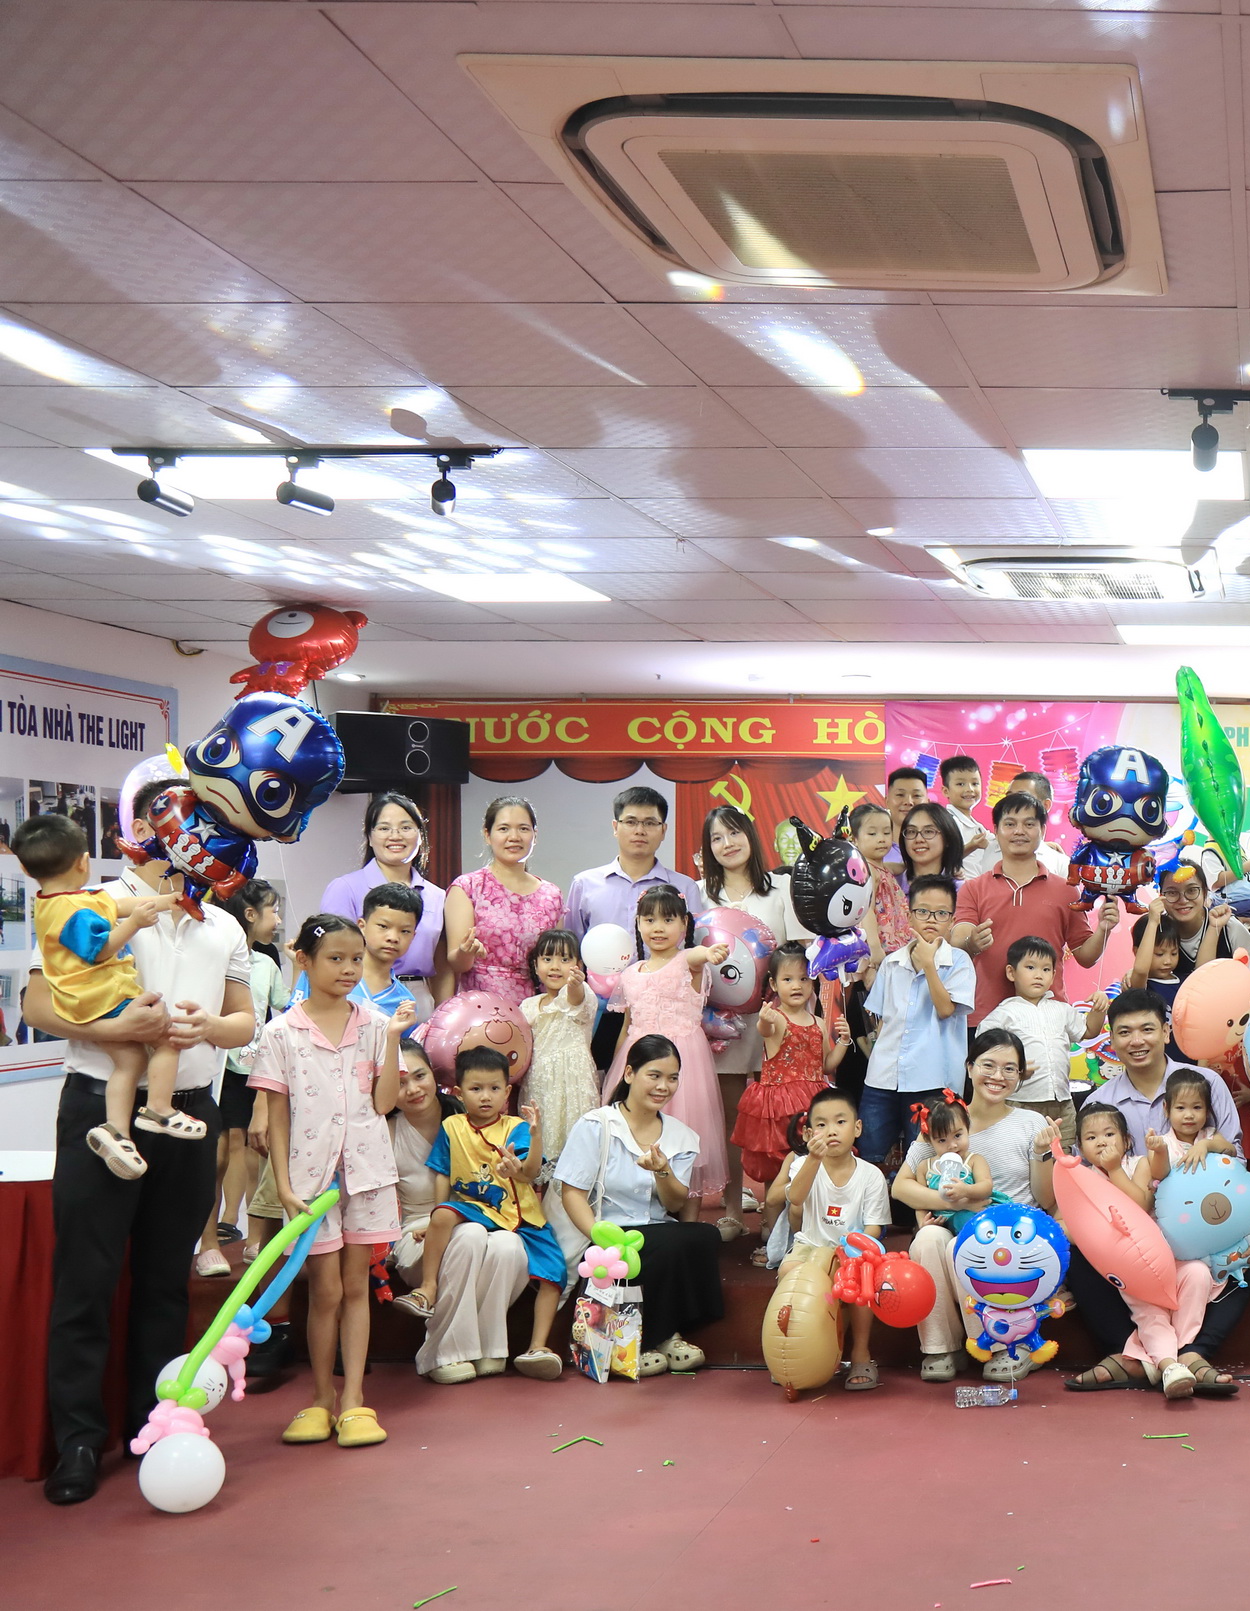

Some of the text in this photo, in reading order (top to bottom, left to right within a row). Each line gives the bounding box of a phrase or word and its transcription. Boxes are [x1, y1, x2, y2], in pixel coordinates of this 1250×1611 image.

[8, 695, 38, 737] TÒA
[43, 704, 74, 742] NHÀ
[78, 712, 104, 746] THE
[108, 717, 146, 752] LIGHT
[627, 710, 776, 750] CỘNG
[812, 711, 885, 745] HÒ
